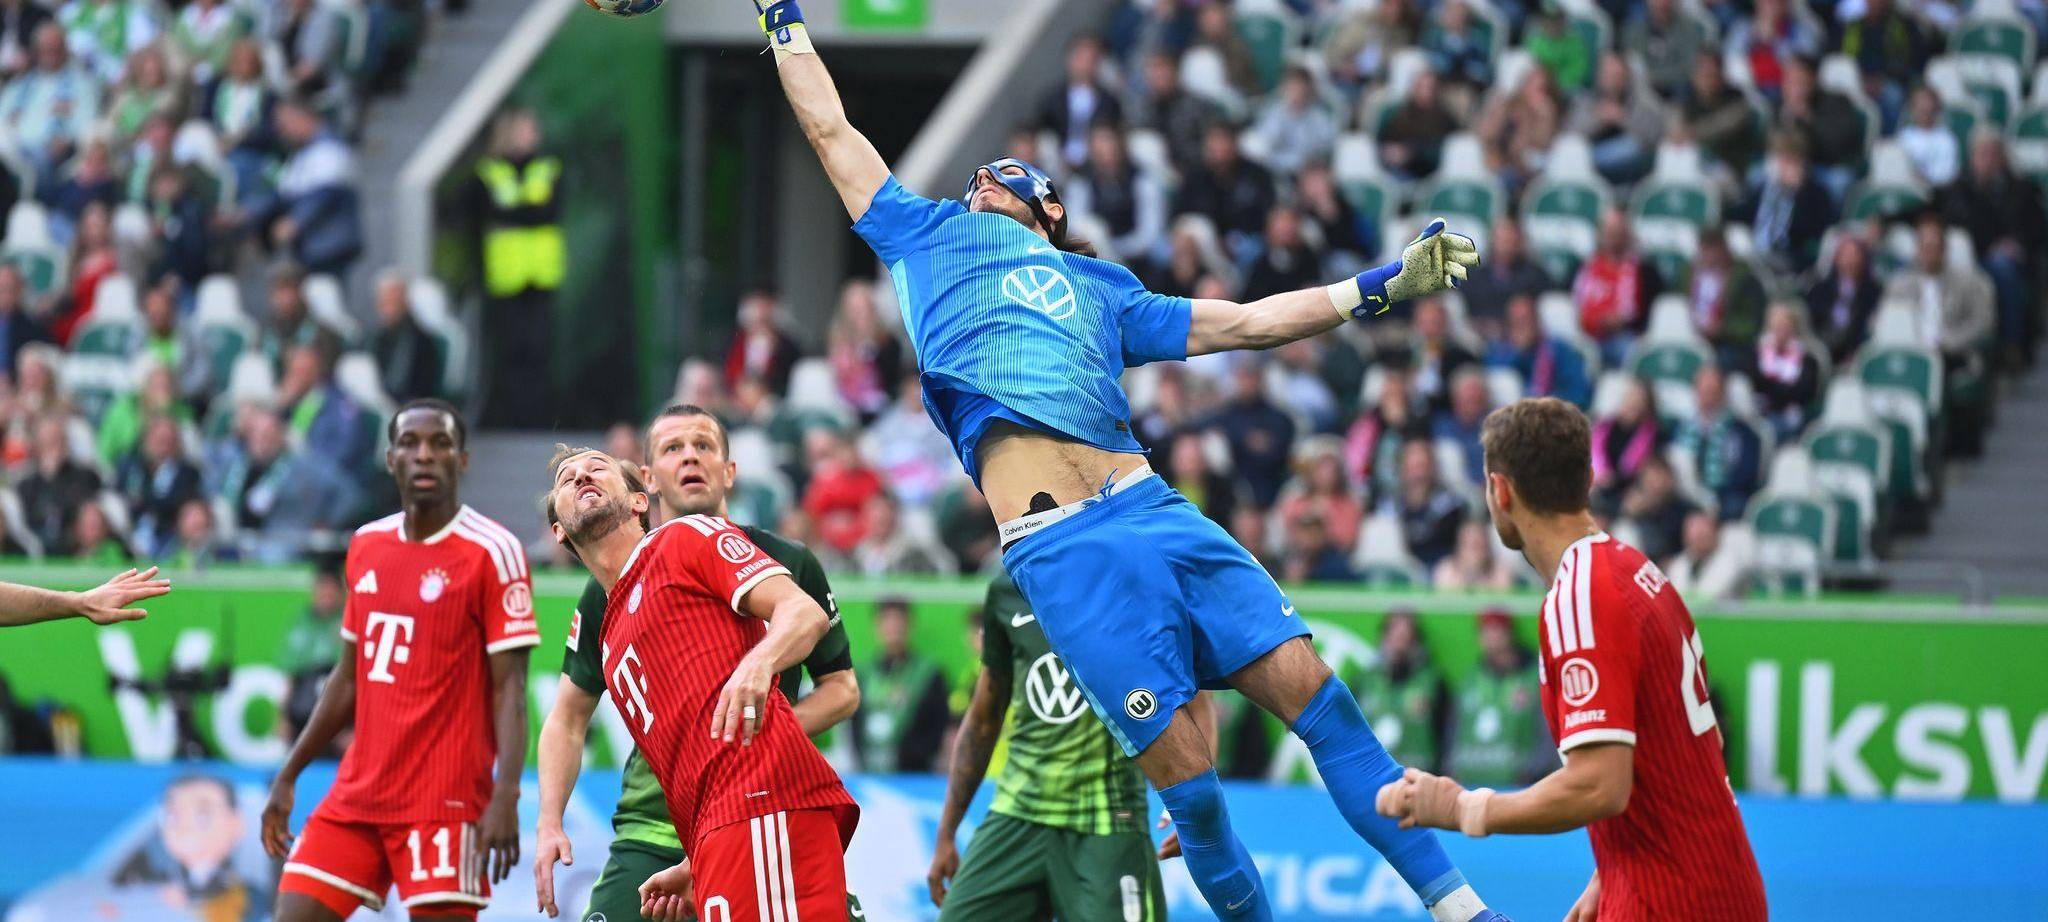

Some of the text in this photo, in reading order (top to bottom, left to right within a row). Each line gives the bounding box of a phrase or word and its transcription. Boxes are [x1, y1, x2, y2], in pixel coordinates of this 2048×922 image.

[1004, 520, 1043, 537] Calvin Klein
[407, 827, 457, 882] 11
